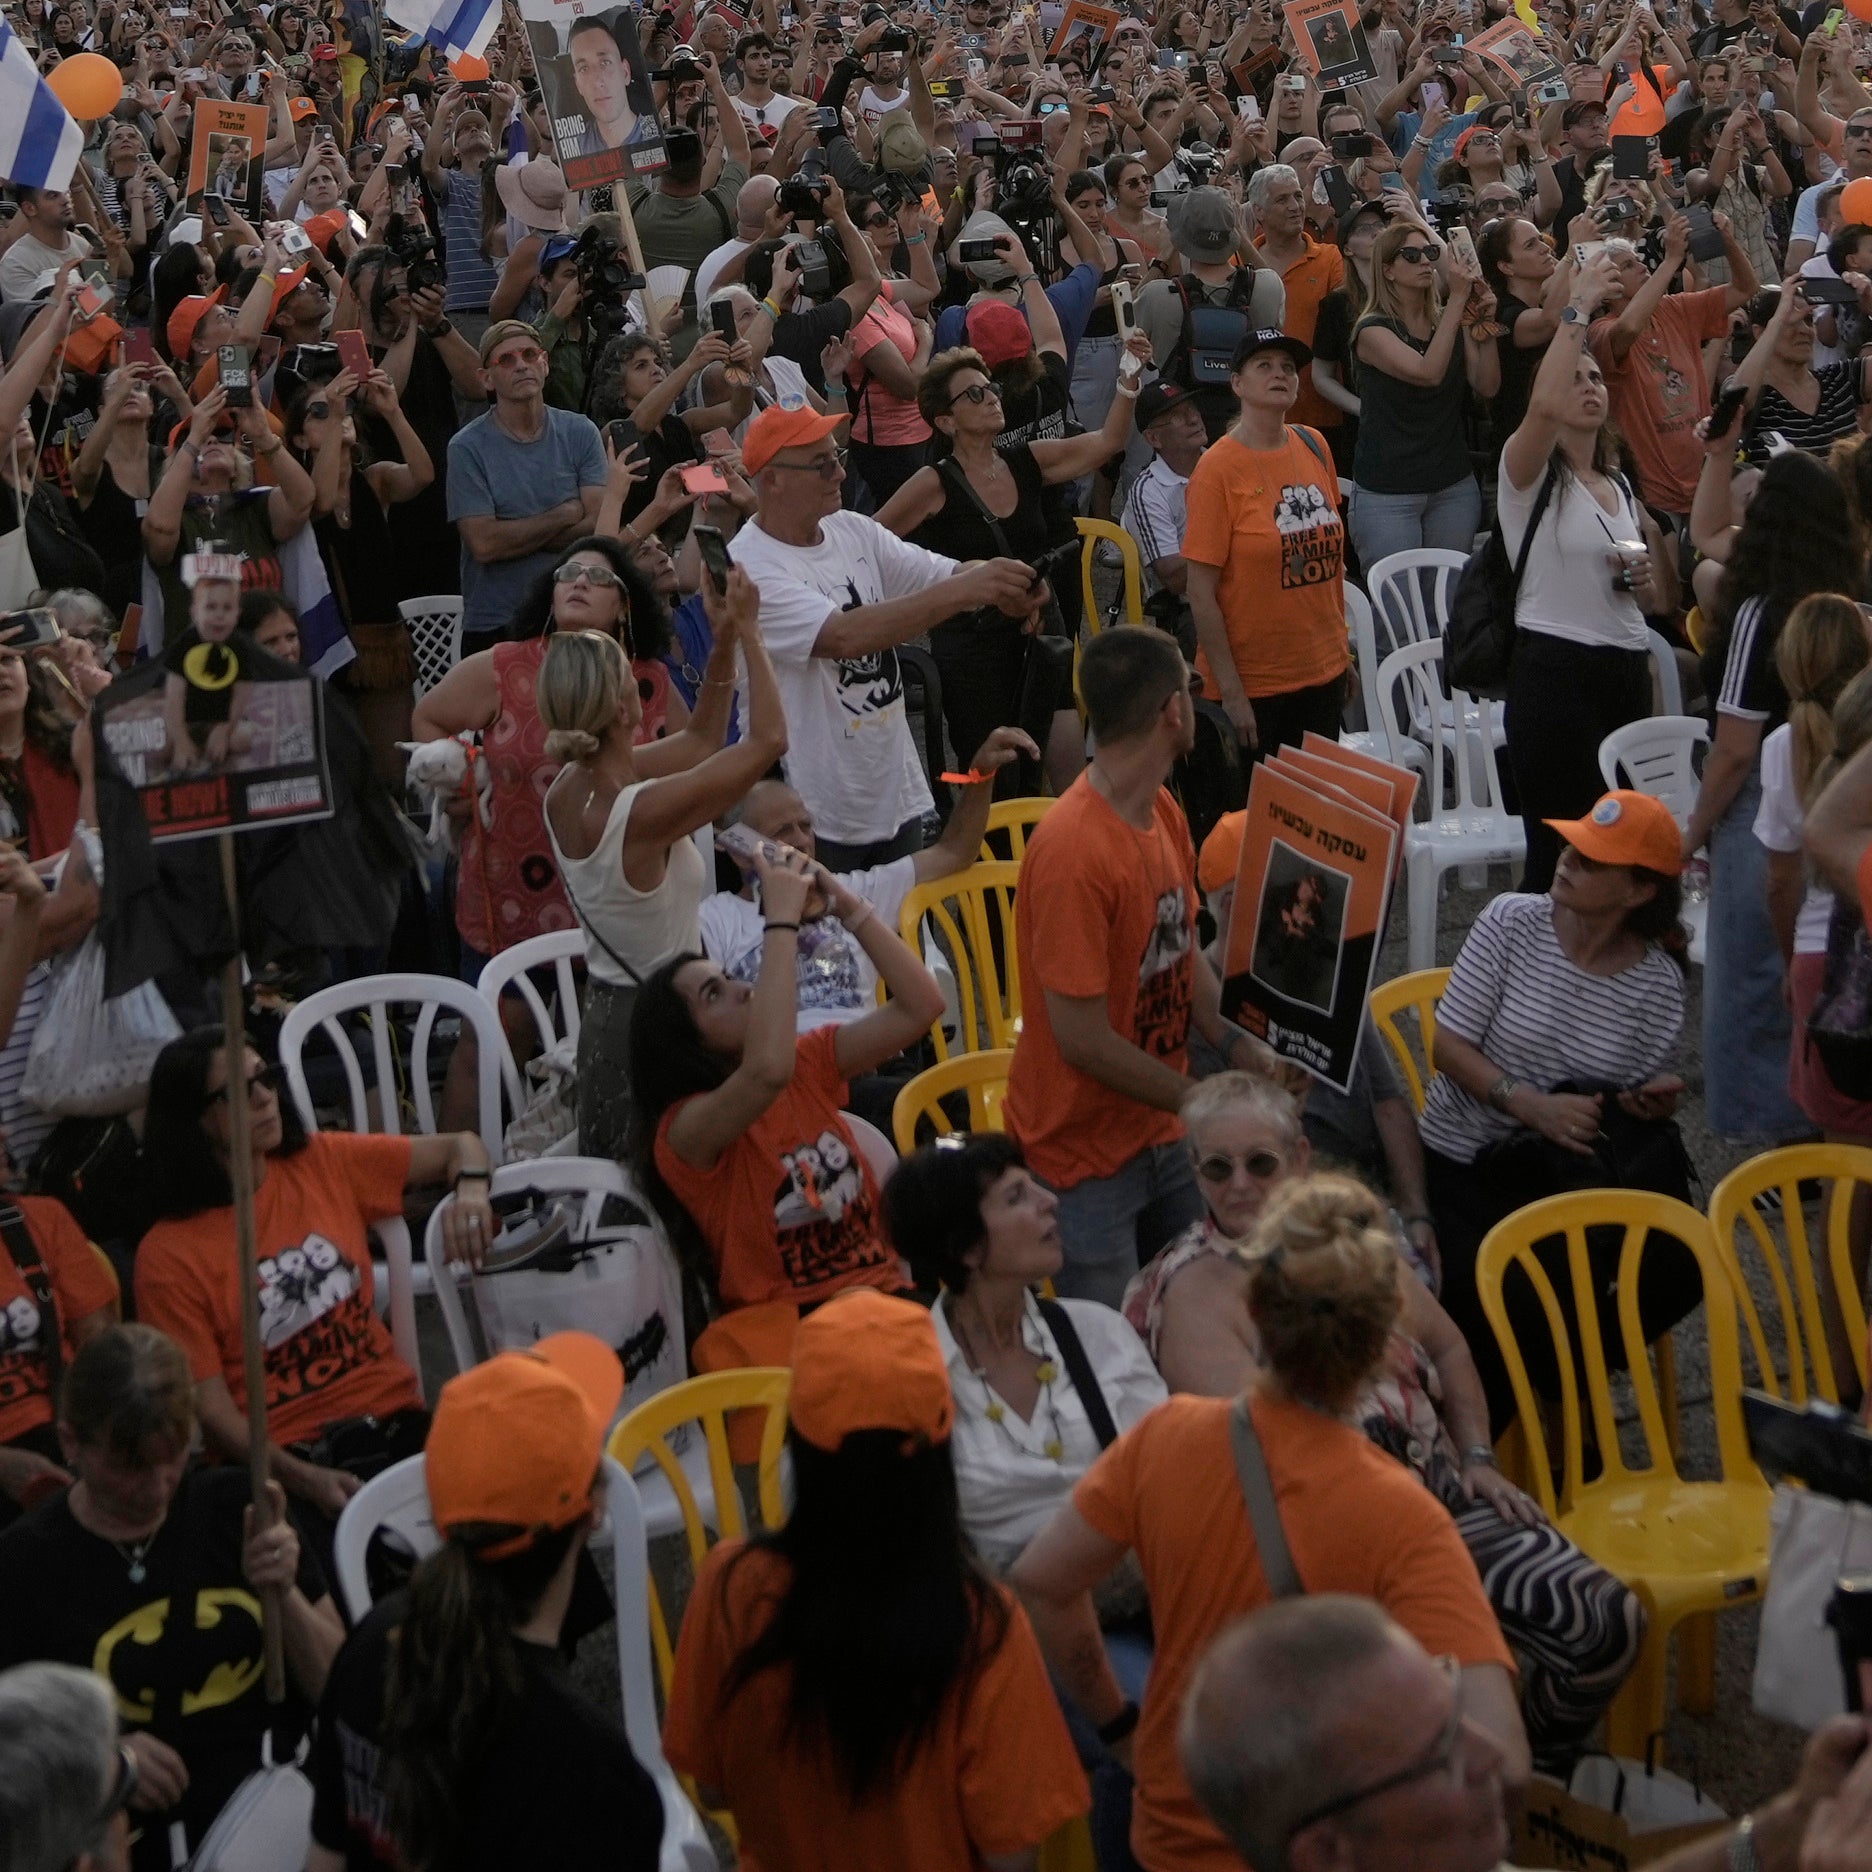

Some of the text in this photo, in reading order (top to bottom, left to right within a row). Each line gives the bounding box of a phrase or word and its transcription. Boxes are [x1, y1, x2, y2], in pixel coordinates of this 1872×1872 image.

[555, 114, 586, 139] BRING
[559, 136, 582, 160] HIM
[222, 378, 249, 388] HMS
[223, 369, 248, 380] FCK
[1281, 522, 1341, 548] FREE MY
[1281, 536, 1343, 566] FAMILY
[1281, 551, 1342, 589] NOW
[1268, 801, 1368, 863] עסקה עכשיו!
